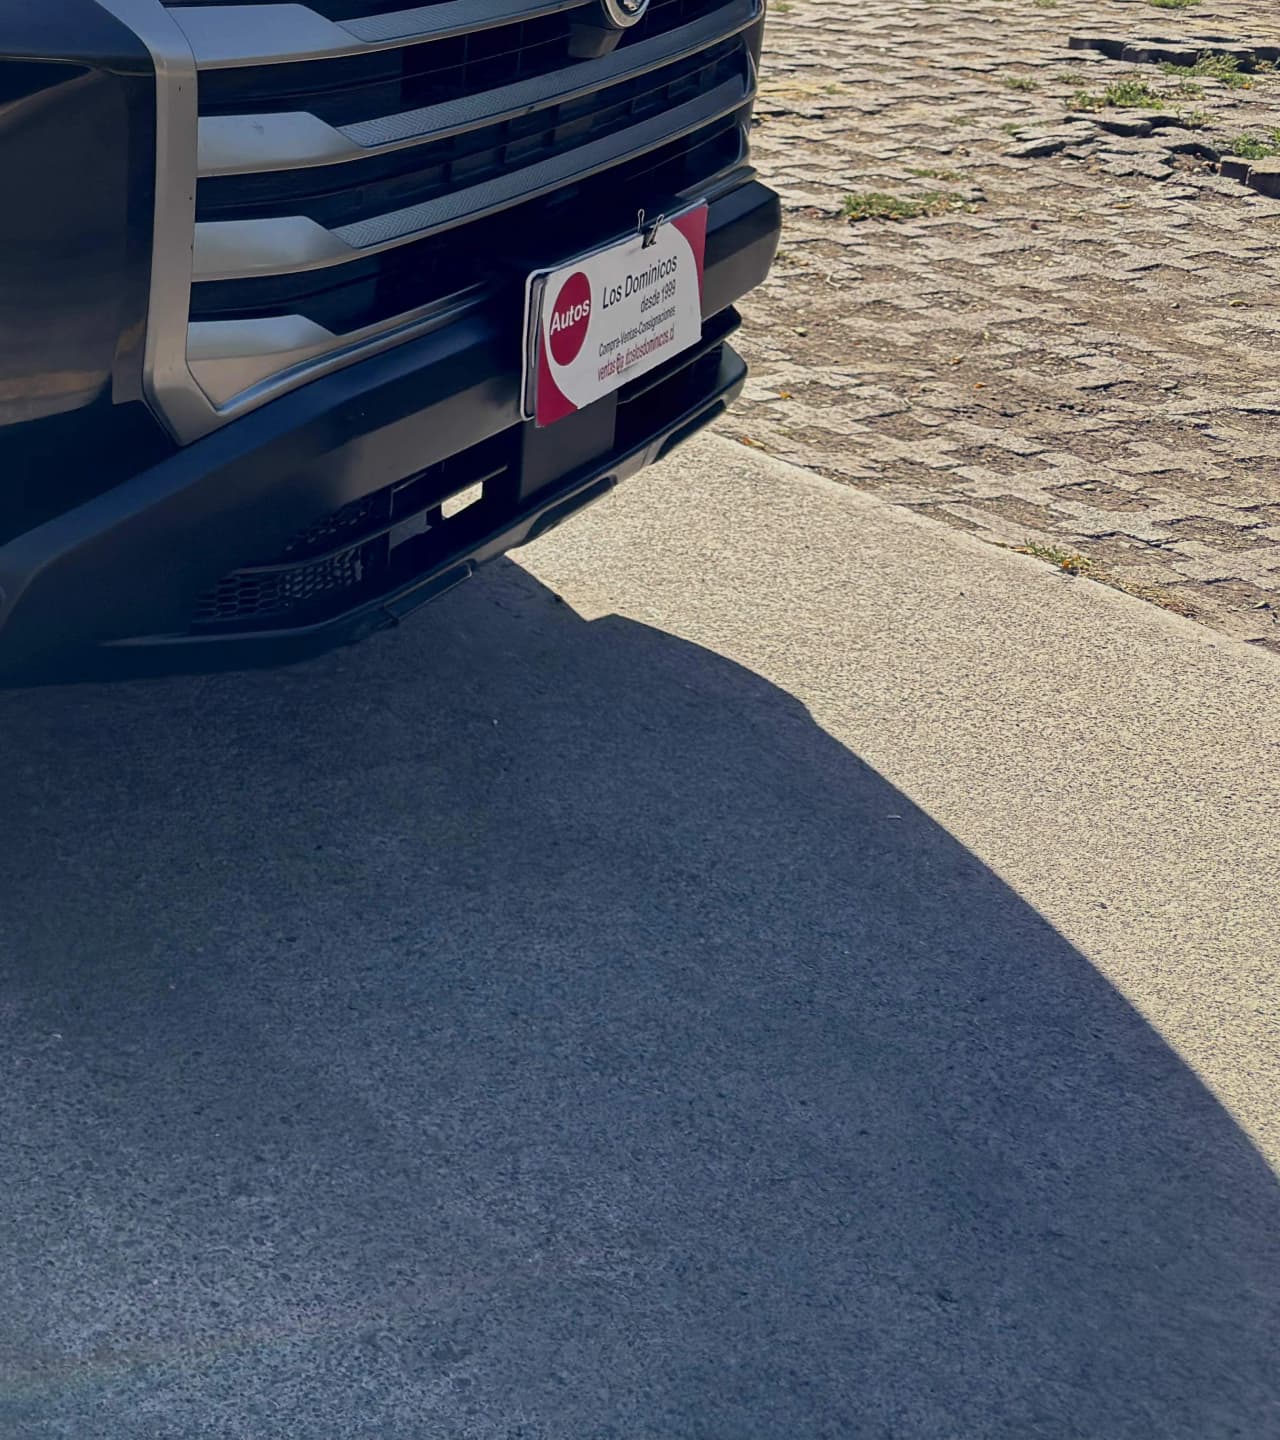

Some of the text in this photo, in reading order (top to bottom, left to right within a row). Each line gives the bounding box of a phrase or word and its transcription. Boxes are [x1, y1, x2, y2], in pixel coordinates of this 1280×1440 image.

[603, 285, 622, 309] Los
[640, 289, 660, 313] desde
[550, 300, 590, 336] Autos
